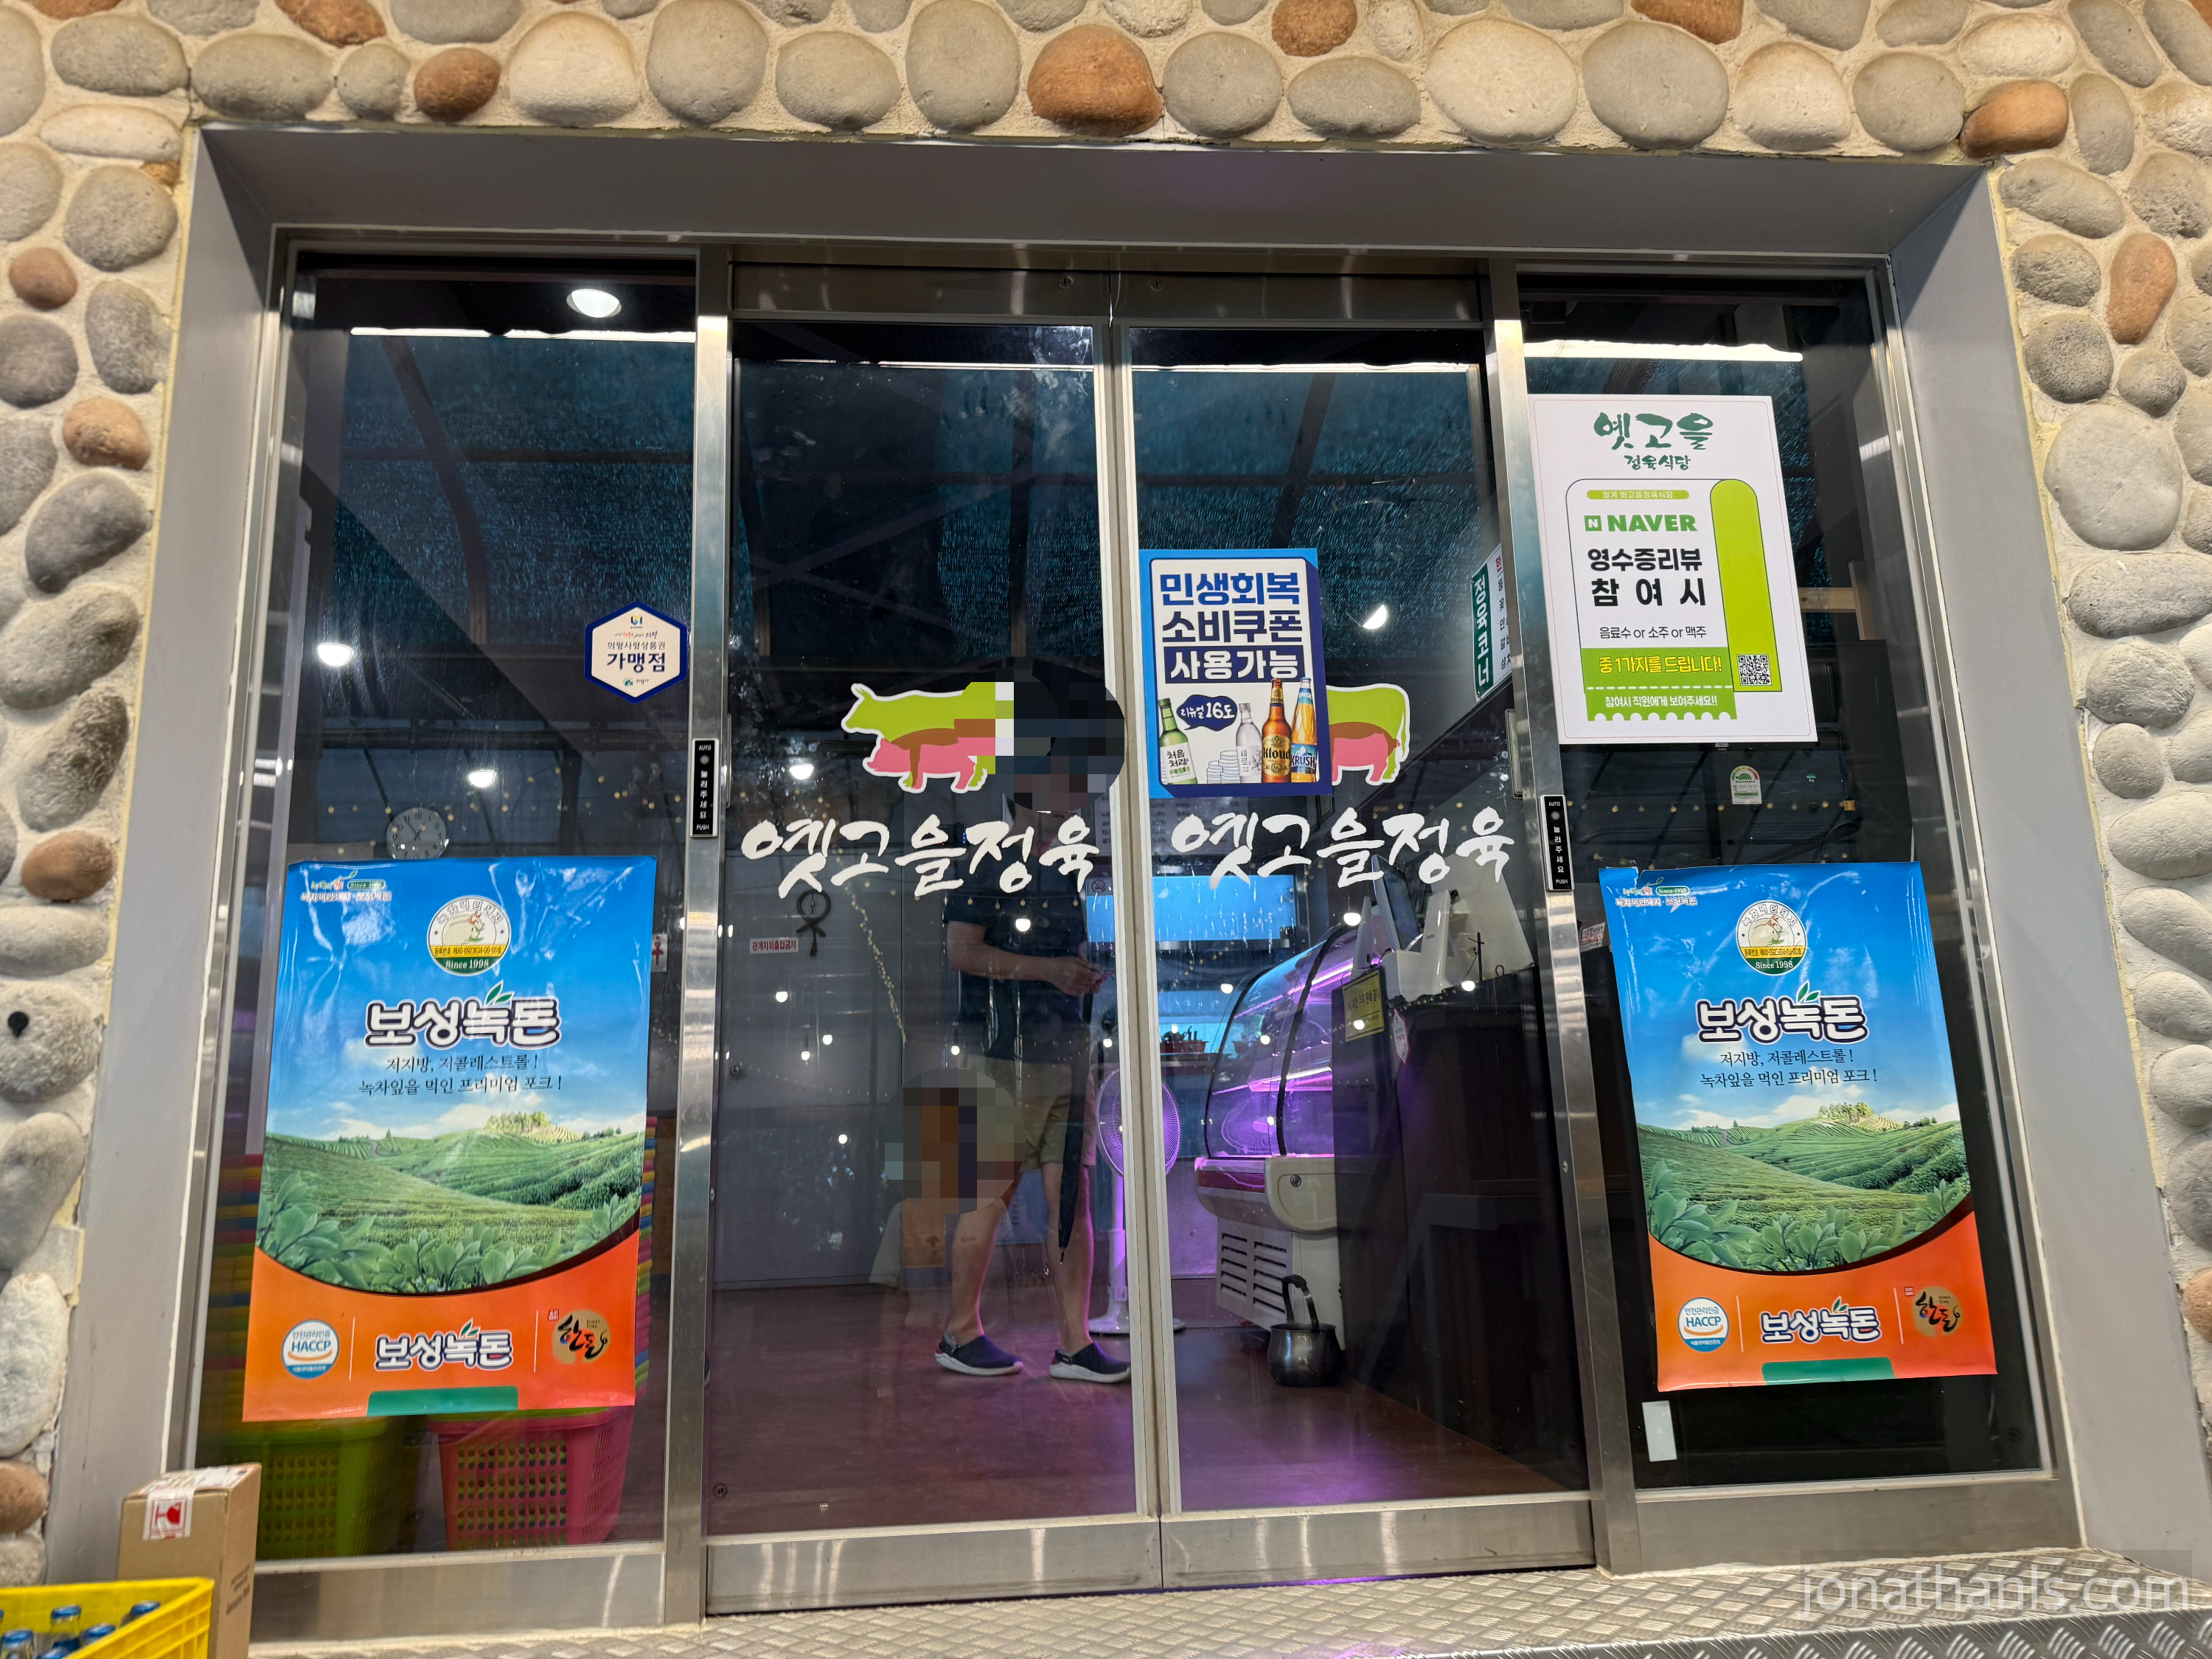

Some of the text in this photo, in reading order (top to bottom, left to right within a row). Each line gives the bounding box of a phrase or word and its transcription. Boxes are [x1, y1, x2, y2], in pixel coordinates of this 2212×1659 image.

[1593, 411, 1714, 451] 옛고을
[1624, 454, 1691, 470] 정육식당
[1607, 515, 1698, 532] NAVER
[1587, 548, 1703, 571] 영수증리뷰
[1160, 572, 1300, 606] 민생회복
[1162, 610, 1303, 643] 소비쿠폰
[1475, 574, 1489, 687] 정육코너
[1599, 626, 1707, 639] 음료수 or 소주 or 맥주
[607, 641, 666, 650] 의왕사랑상품권
[607, 653, 665, 673] 가맹점
[1599, 655, 1722, 673] 중 1가지를 드립니다!
[1605, 695, 1718, 708] 참여시 직원에게 보여주세요!!
[1180, 702, 1235, 720] 리뉴얼 16도
[1166, 749, 1185, 759] 처음
[1263, 748, 1290, 759] Kloud
[1292, 755, 1315, 769] KRUSH
[1169, 758, 1188, 768] 처럼
[741, 814, 1100, 899] 옛고을정육
[1171, 806, 1515, 890] 옛고을정육
[1554, 826, 1565, 873] 눌러주세요
[445, 959, 489, 970] Since 1998
[1775, 961, 1793, 969] 1998
[365, 997, 562, 1050] 보성녹돈
[1696, 995, 1870, 1045] 보성녹돈
[386, 1056, 434, 1074] 저지방,
[1720, 1051, 1764, 1067] 저지방,
[359, 1078, 420, 1096] 녹차잎을
[425, 1077, 454, 1095] 먹인
[458, 1076, 518, 1093] 프리미엄
[1700, 1072, 1754, 1088] 녹차잎을
[1758, 1071, 1784, 1087] 먹인
[1788, 1069, 1839, 1085] 프리미엄
[1686, 1316, 1722, 1327] HACCP
[1760, 1306, 1882, 1344] 보성녹돈
[291, 1340, 332, 1353] HACCP
[375, 1329, 513, 1371] 보성녹돈
